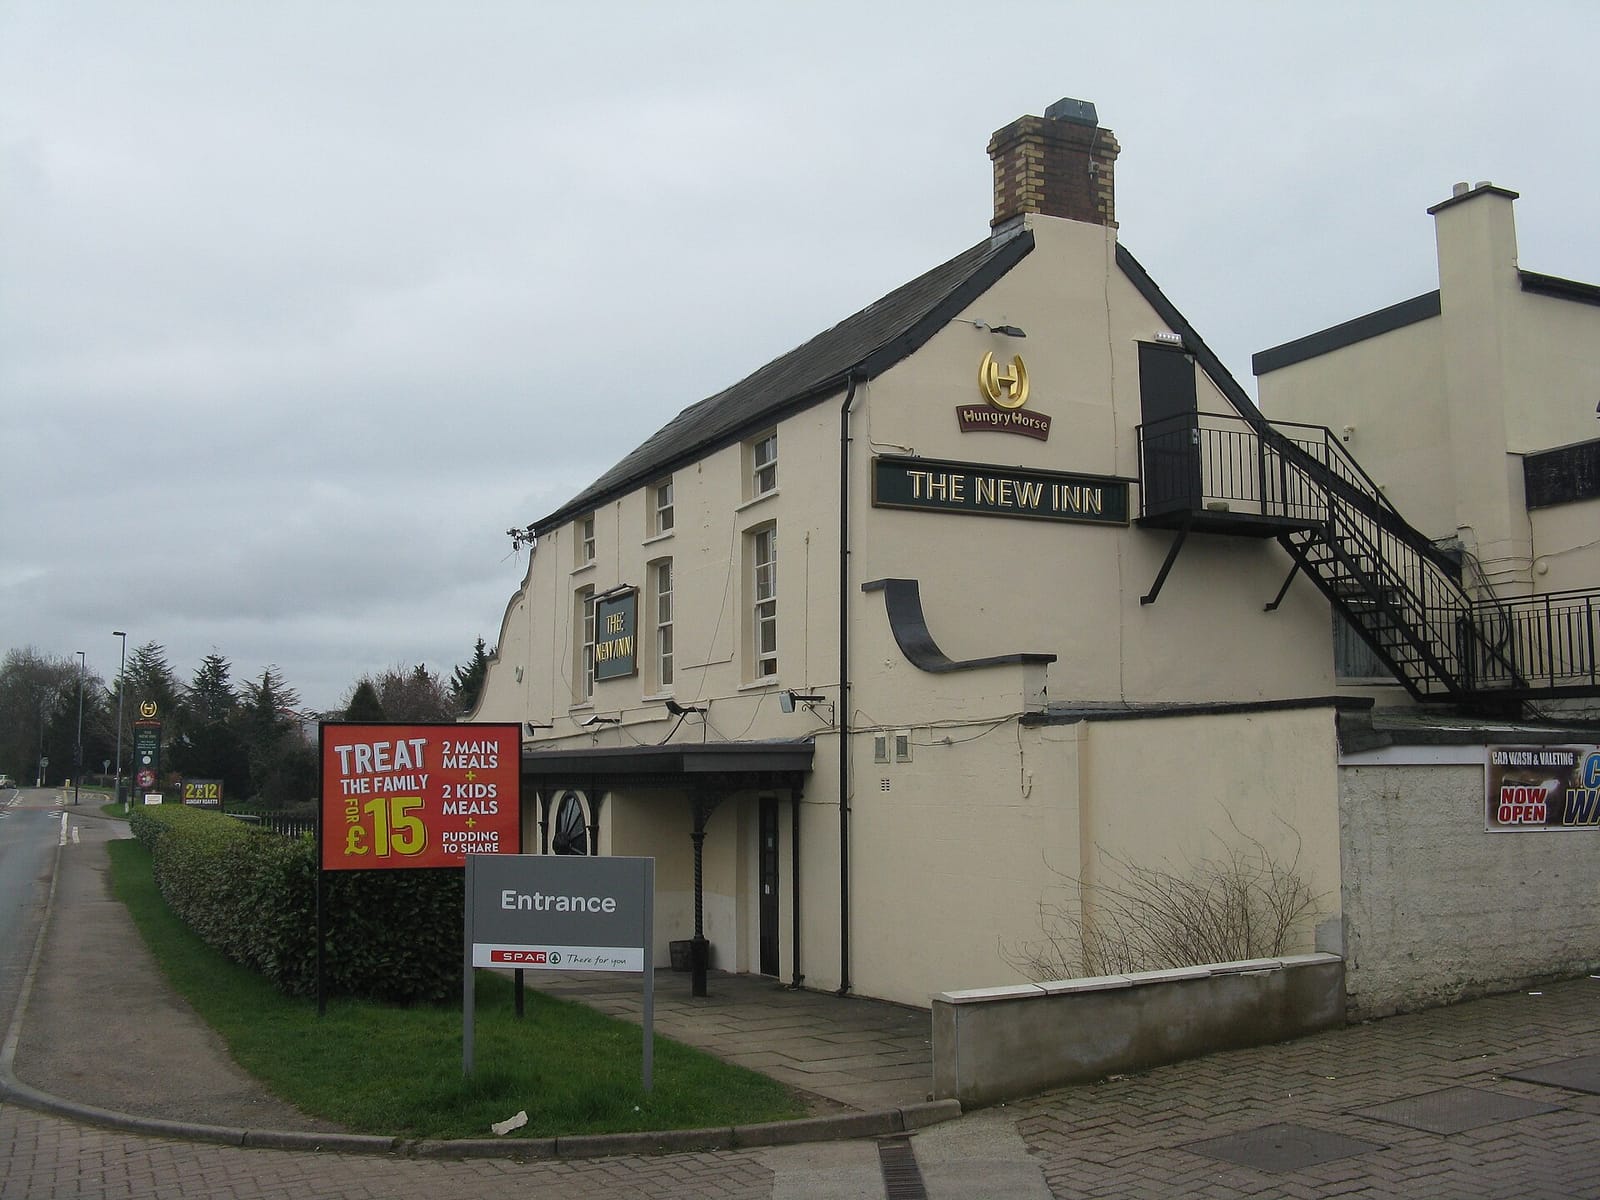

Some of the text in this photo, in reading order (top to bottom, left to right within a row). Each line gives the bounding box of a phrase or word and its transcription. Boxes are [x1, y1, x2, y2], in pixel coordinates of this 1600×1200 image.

[963, 410, 1048, 431] Hungry Horse
[907, 471, 1102, 513] THE NEW INN
[606, 612, 625, 634] THE
[442, 741, 498, 754] 2 MAIN
[334, 738, 427, 775] TREAT
[442, 755, 498, 769] MEALS
[1492, 752, 1574, 765] CAR WASH & VALETING
[186, 784, 194, 798] 2
[340, 774, 429, 795] THE FAMILY
[442, 784, 497, 799] 2 KIDS
[1501, 787, 1548, 804] NOW
[345, 799, 359, 823] FOR
[442, 801, 498, 815] MEALS
[1499, 805, 1545, 822] OPEN
[344, 797, 427, 857] £15
[442, 832, 499, 842] PUDDING
[442, 843, 499, 853] TO SHARE
[501, 889, 617, 914] Entrance
[503, 952, 627, 967] SPAR There for you
